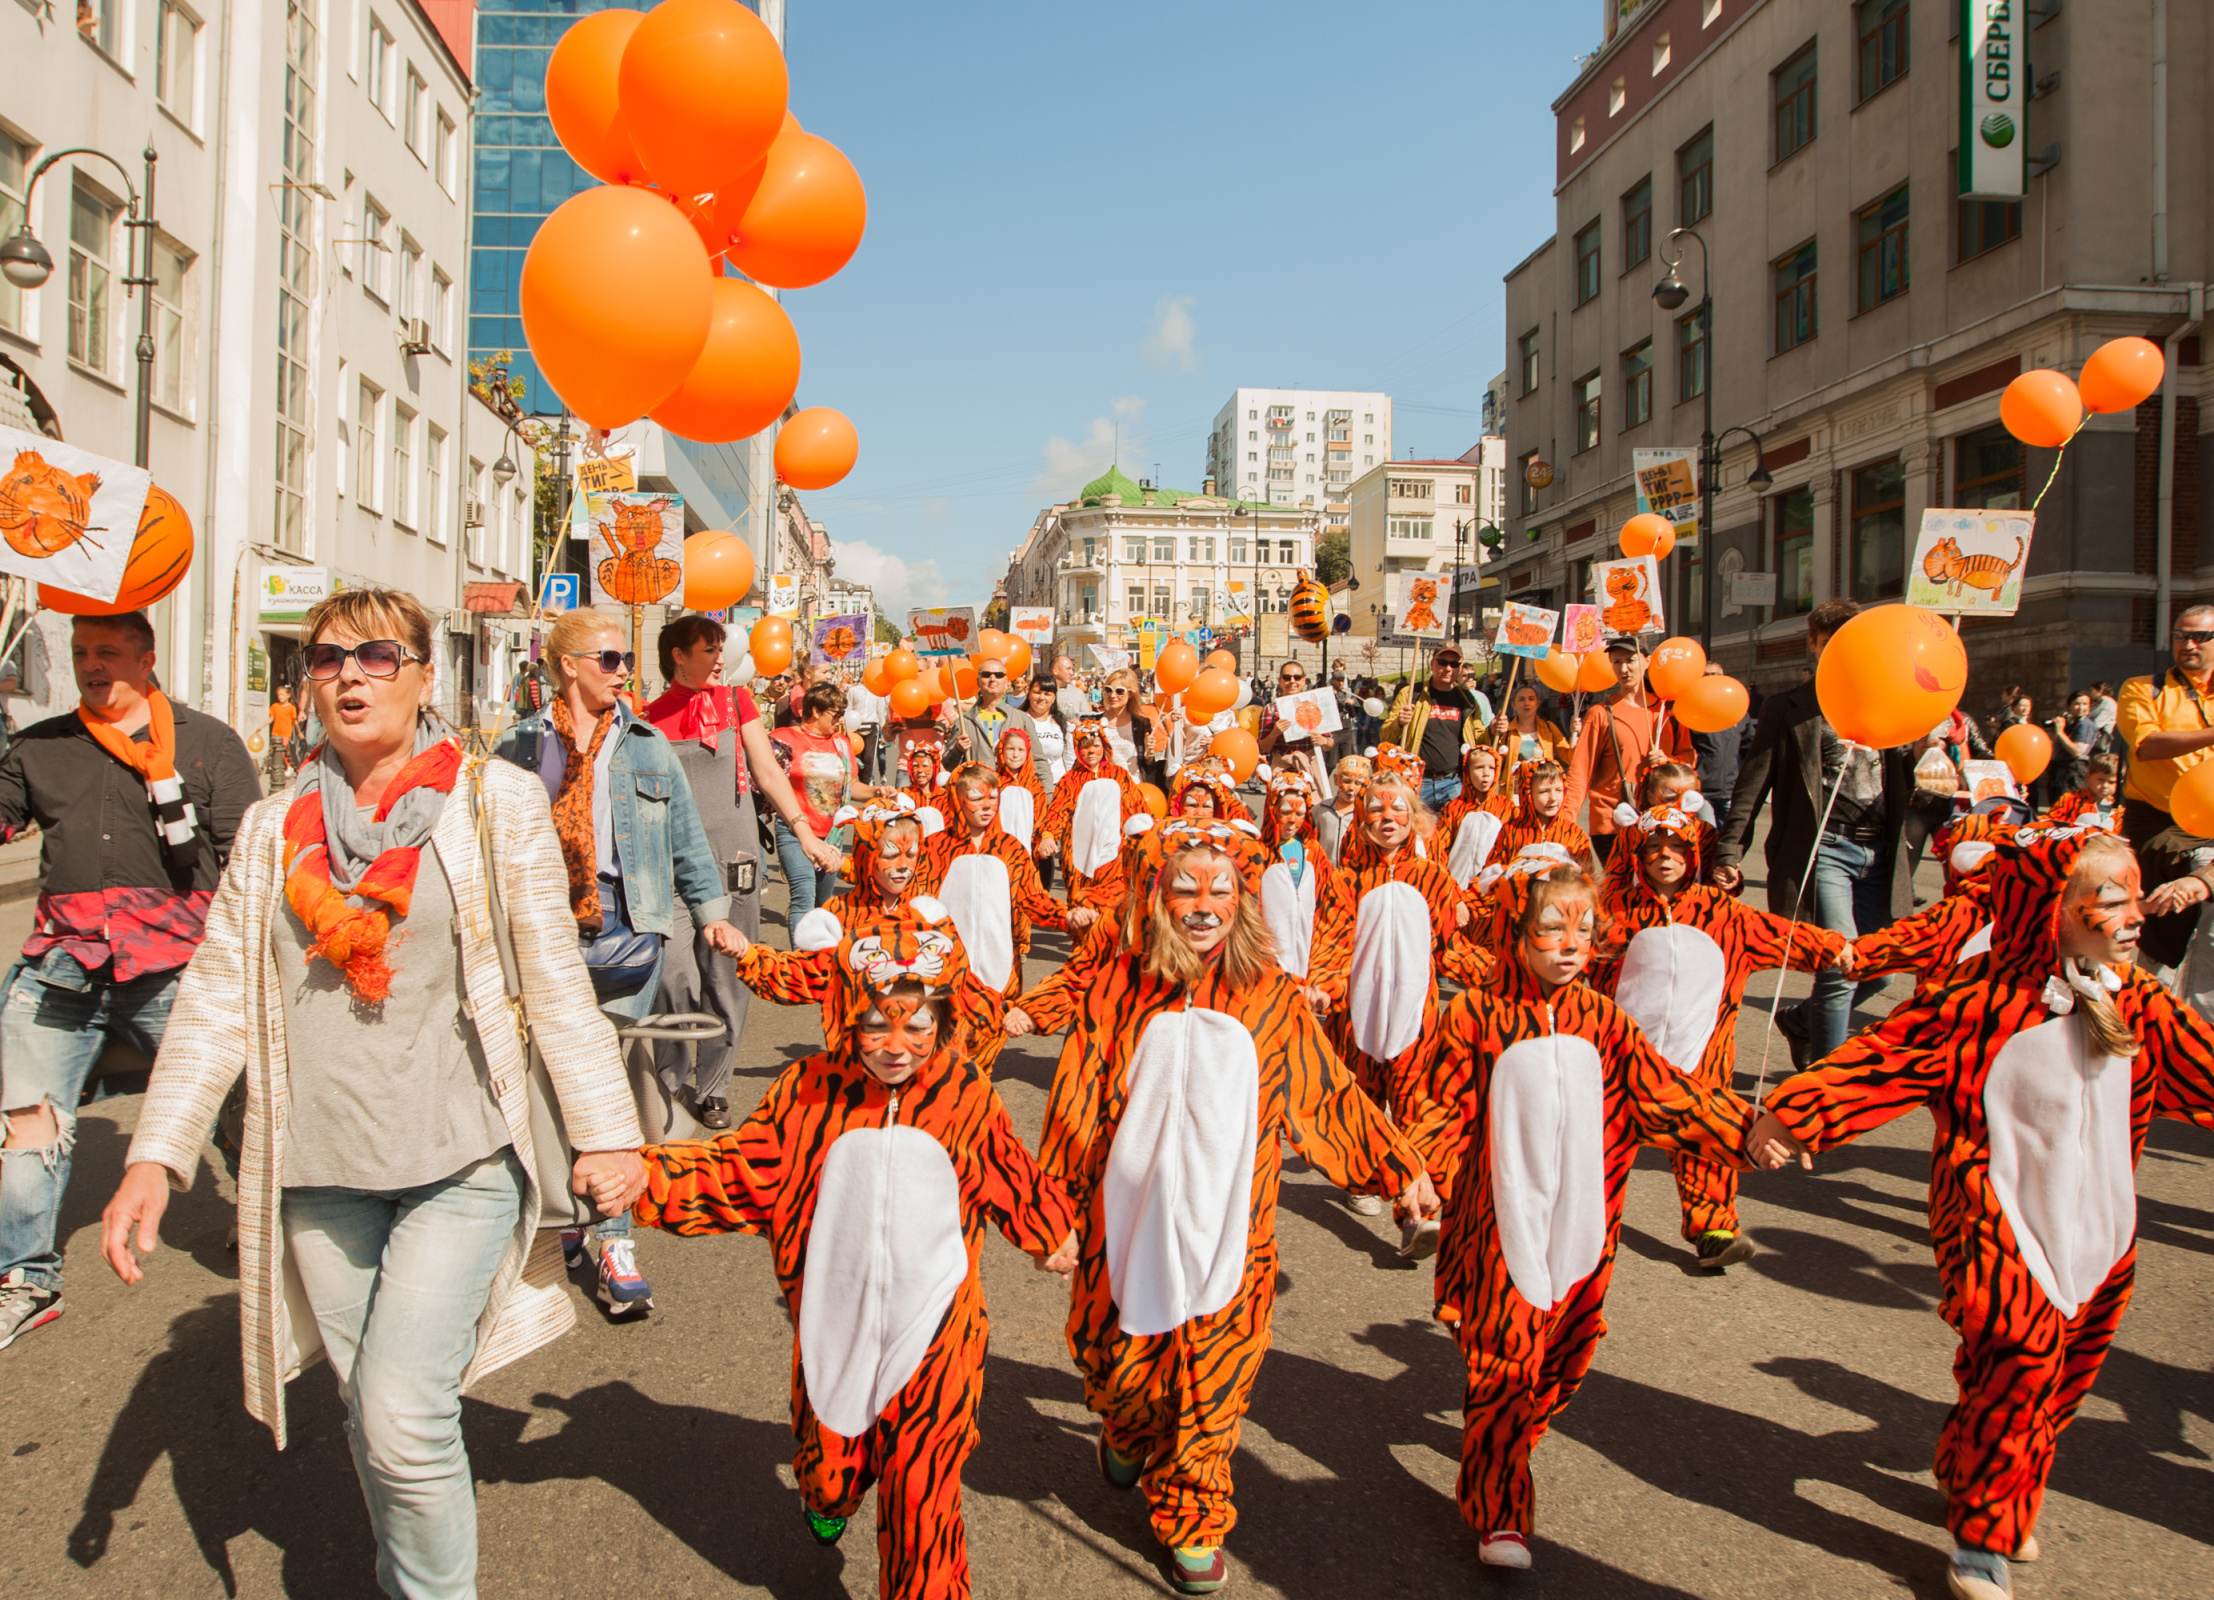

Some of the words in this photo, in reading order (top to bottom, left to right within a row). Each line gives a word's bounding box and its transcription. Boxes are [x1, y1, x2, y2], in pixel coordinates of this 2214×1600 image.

[1986, 0, 2010, 103] СБЕРБ
[580, 461, 608, 476] ДЕНЬ
[1531, 466, 1547, 477] 24
[1641, 469, 1667, 483] ДЕНЬ
[289, 585, 323, 595] КАССА
[551, 578, 571, 606] P
